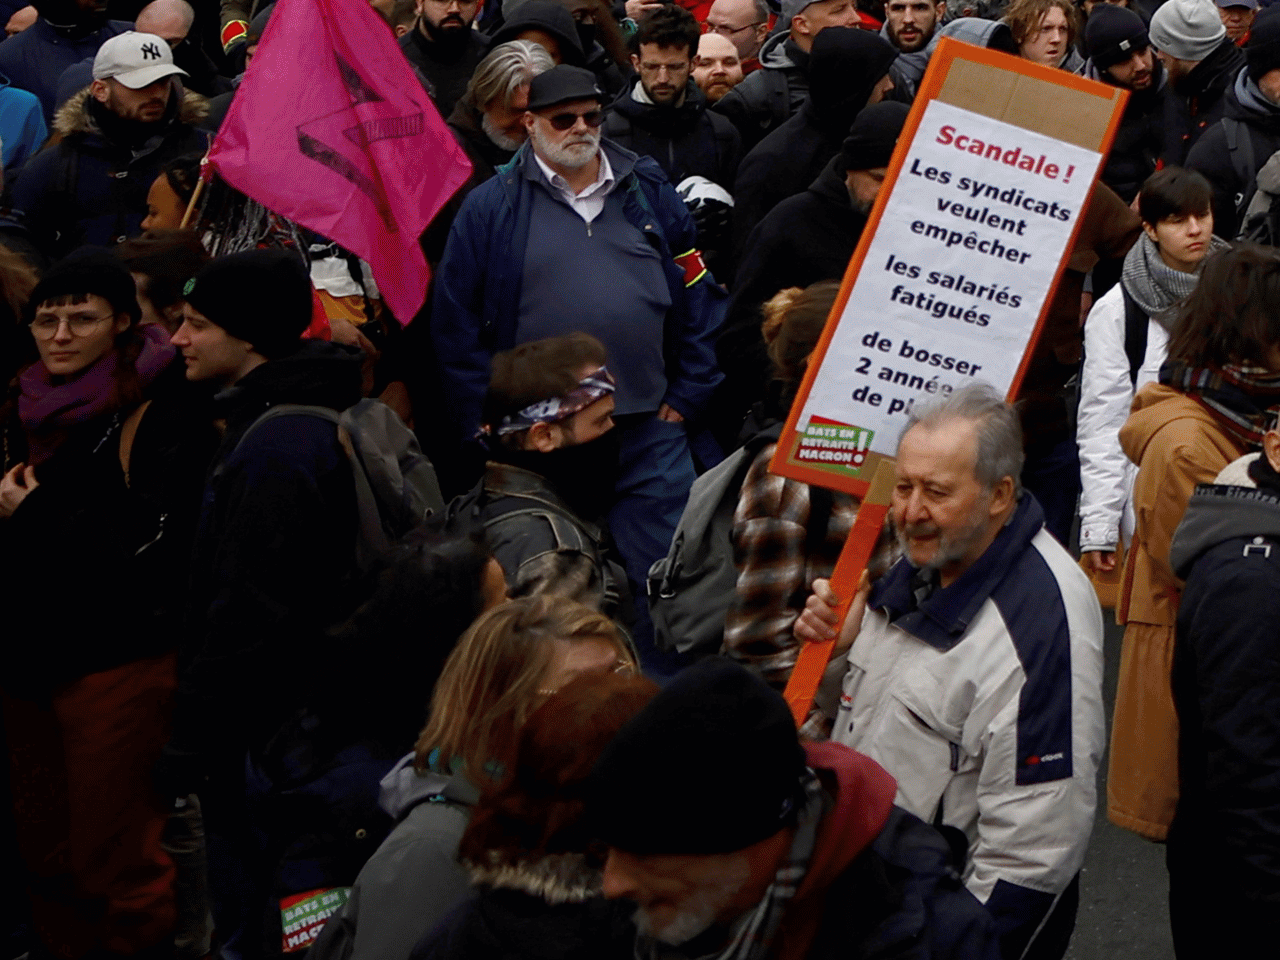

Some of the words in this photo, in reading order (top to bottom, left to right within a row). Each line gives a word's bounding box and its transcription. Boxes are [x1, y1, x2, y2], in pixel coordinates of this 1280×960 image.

[909, 157, 952, 187] Les
[957, 172, 1072, 223] syndicats
[936, 196, 1028, 237] veulent
[909, 217, 1032, 266] empêcher
[884, 254, 922, 282] les
[925, 266, 1023, 310] salariés
[890, 284, 991, 329] fatigués
[861, 329, 893, 354] de
[899, 338, 983, 379] bosser
[852, 383, 883, 408] de
[855, 356, 871, 376] 2
[877, 365, 953, 400] année
[801, 438, 855, 451] RETRAITE
[807, 426, 837, 438] BATS
[839, 429, 855, 439] EN
[799, 448, 853, 463] MACRON
